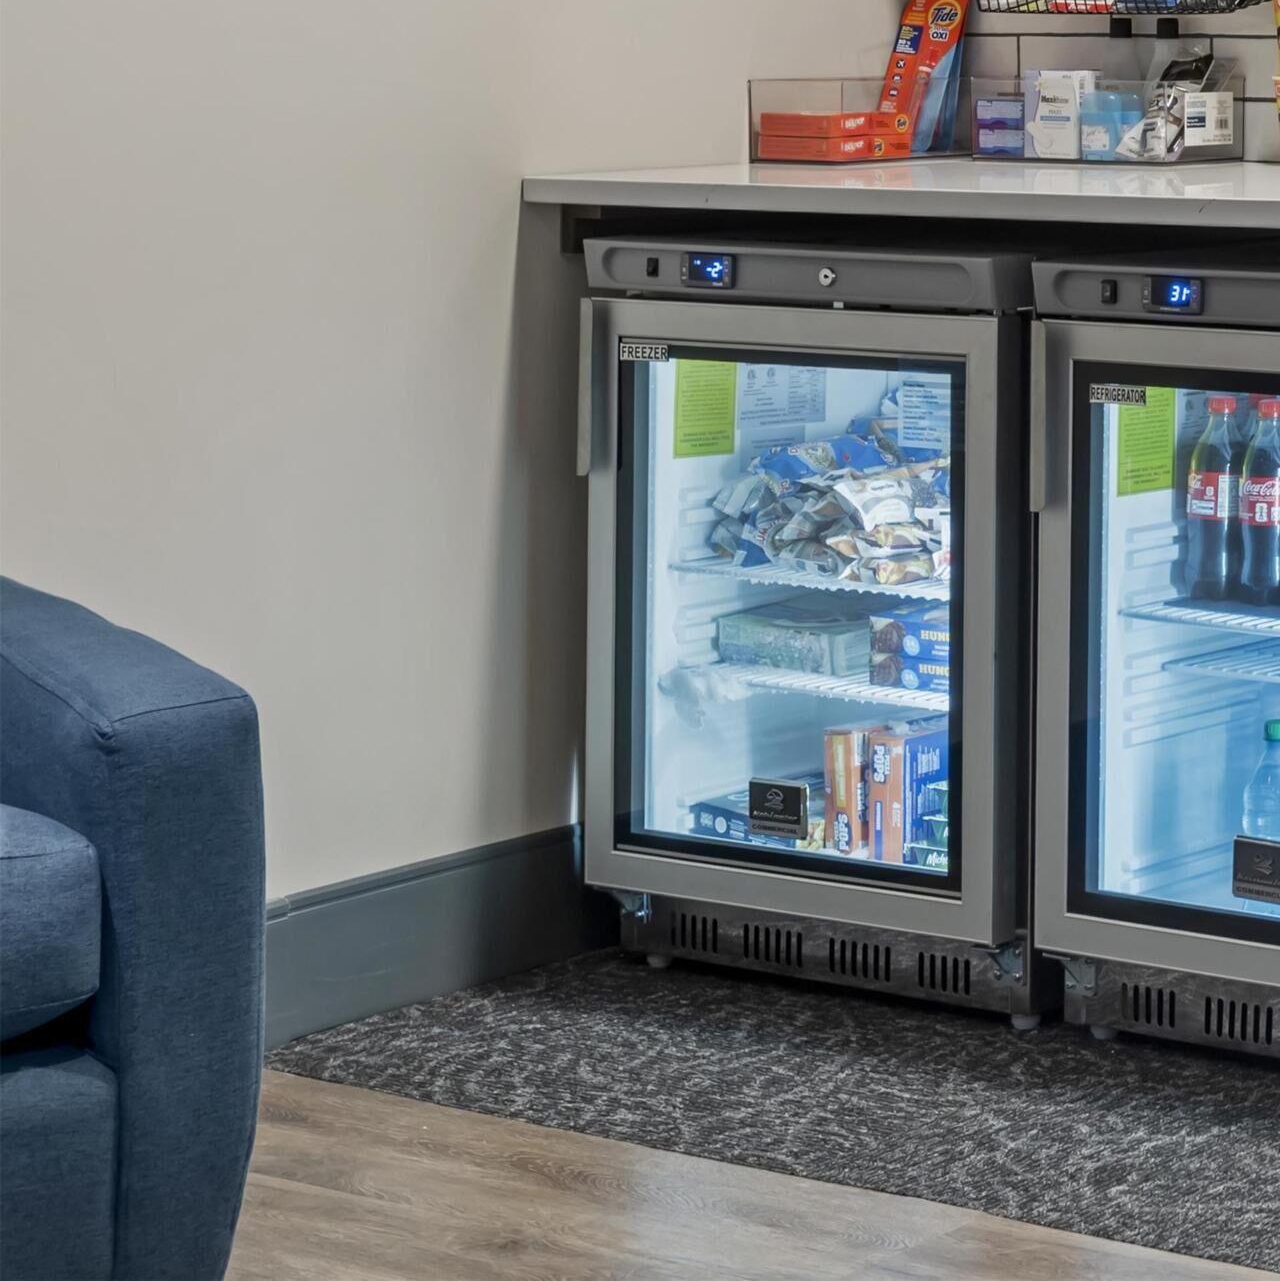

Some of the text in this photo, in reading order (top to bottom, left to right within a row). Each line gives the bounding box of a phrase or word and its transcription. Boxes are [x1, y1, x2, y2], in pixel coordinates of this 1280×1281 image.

[930, 6, 959, 25] Tide
[931, 31, 948, 40] OXI
[621, 345, 668, 360] FREEZER
[1091, 387, 1145, 403] REFRIGERATOR
[873, 745, 886, 784] POPS
[838, 814, 848, 852] POPS
